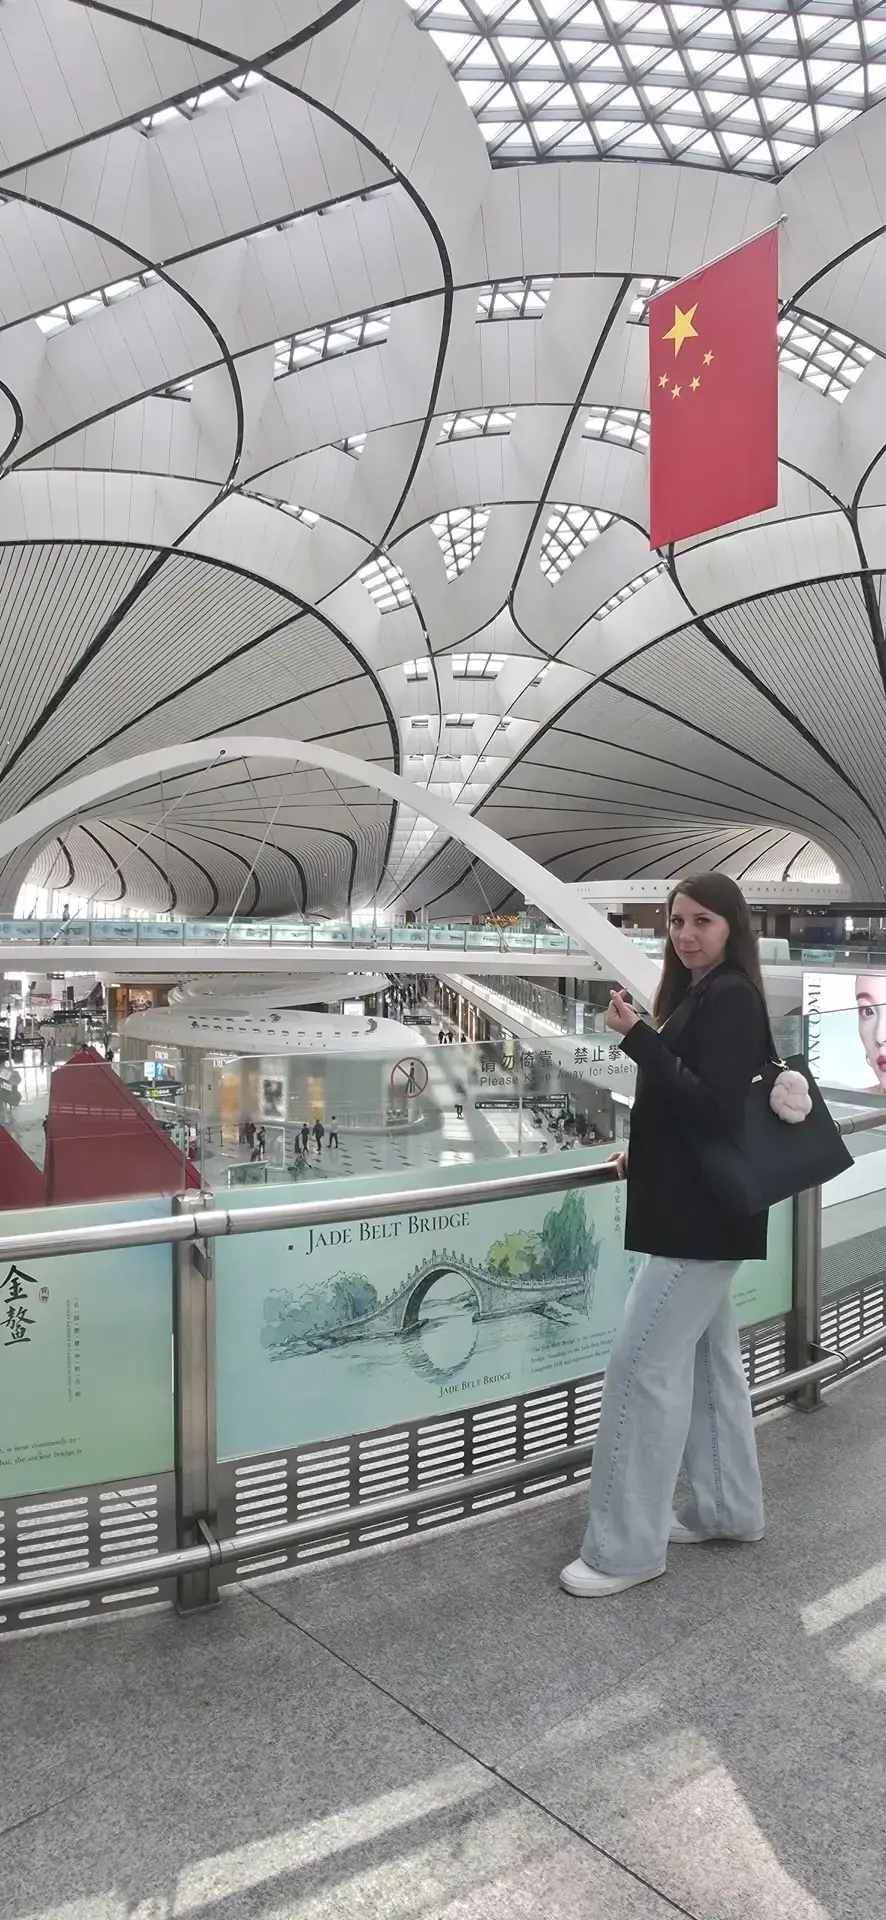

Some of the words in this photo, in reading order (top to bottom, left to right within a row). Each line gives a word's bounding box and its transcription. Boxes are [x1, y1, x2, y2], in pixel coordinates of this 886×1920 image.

[155, 1050, 169, 1060] DIOR
[480, 1075, 519, 1087] Please
[525, 1071, 552, 1083] Keep
[557, 1069, 584, 1081] Away
[589, 1066, 603, 1077] for
[607, 1063, 637, 1076] Safety
[306, 1229, 352, 1255] JADE
[360, 1222, 402, 1242] BELT
[408, 1212, 470, 1235] BRIDGE
[438, 1384, 460, 1399] JADE
[461, 1379, 481, 1391] BELT
[483, 1372, 512, 1385] BRIDGE
